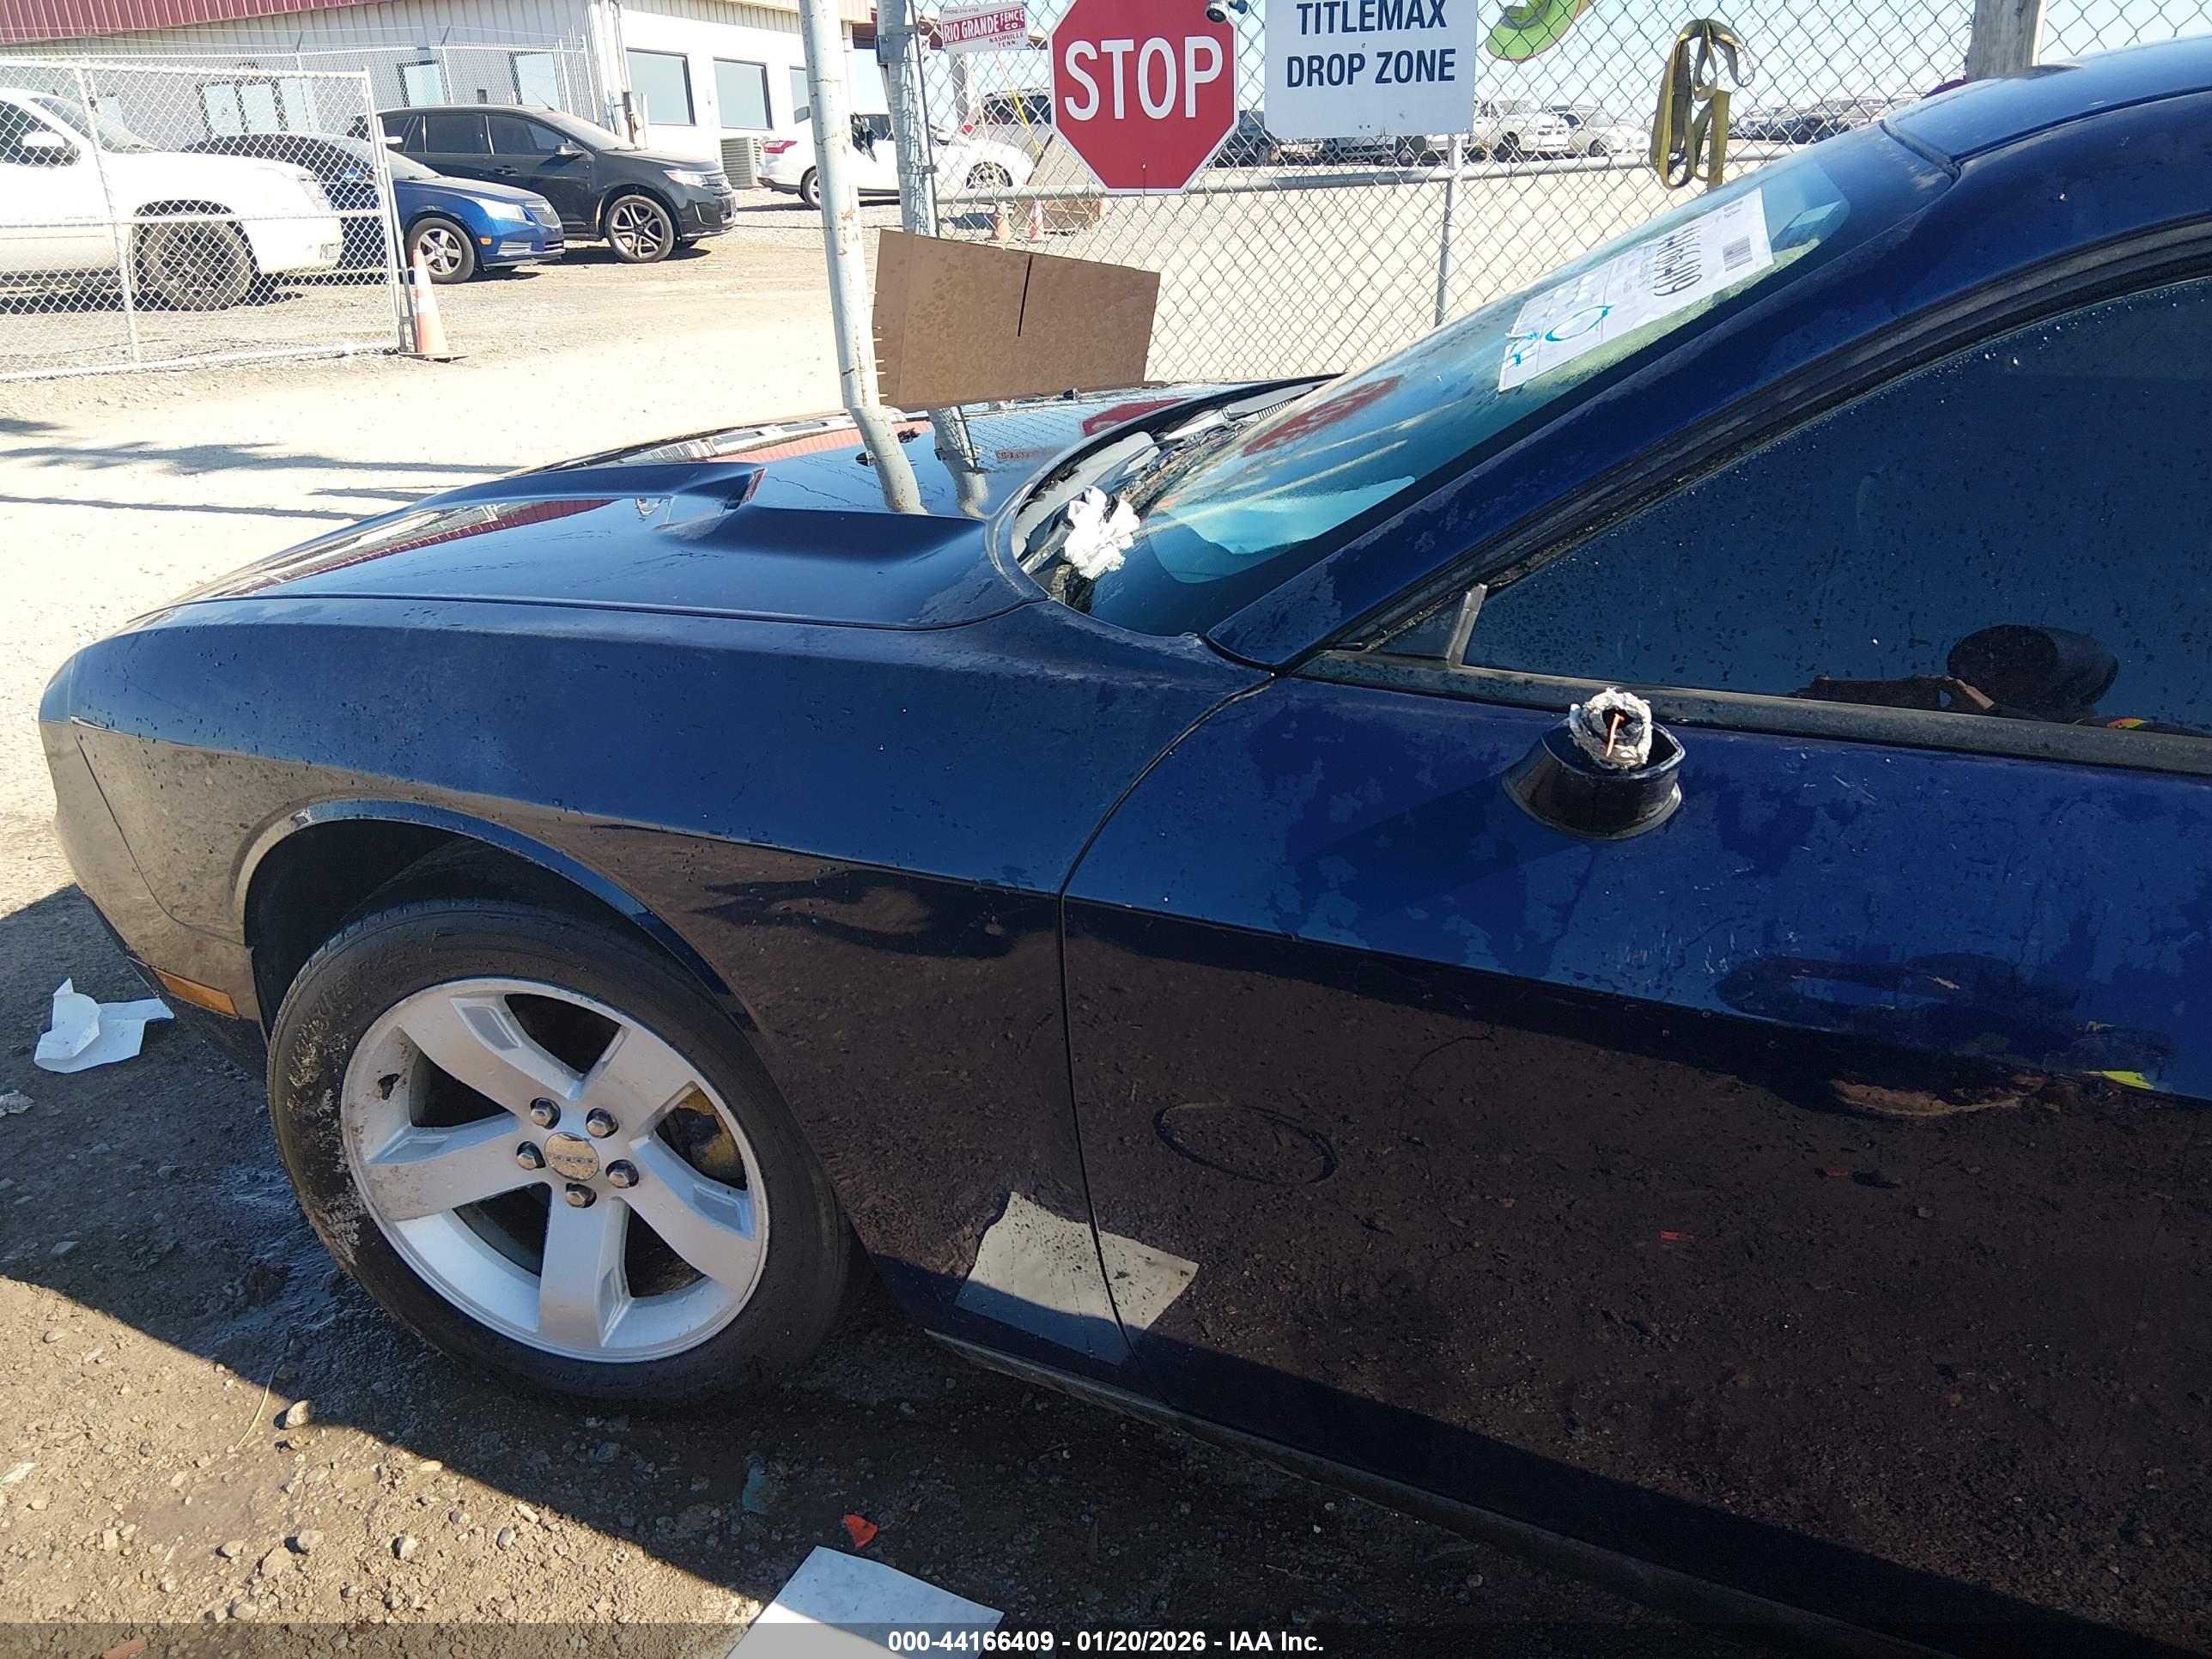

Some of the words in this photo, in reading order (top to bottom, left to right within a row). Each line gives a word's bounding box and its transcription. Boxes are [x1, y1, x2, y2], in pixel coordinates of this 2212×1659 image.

[944, 22, 960, 43] RIO
[961, 14, 1000, 40] GRANDE
[1000, 9, 1024, 26] FENCE
[1004, 21, 1022, 30] CO.
[1296, 0, 1448, 35] TITLEMAX
[988, 31, 1024, 43] NASHVILLE
[1064, 35, 1223, 121] STOP
[1286, 52, 1366, 88] DROP
[1375, 48, 1456, 84] ZONE
